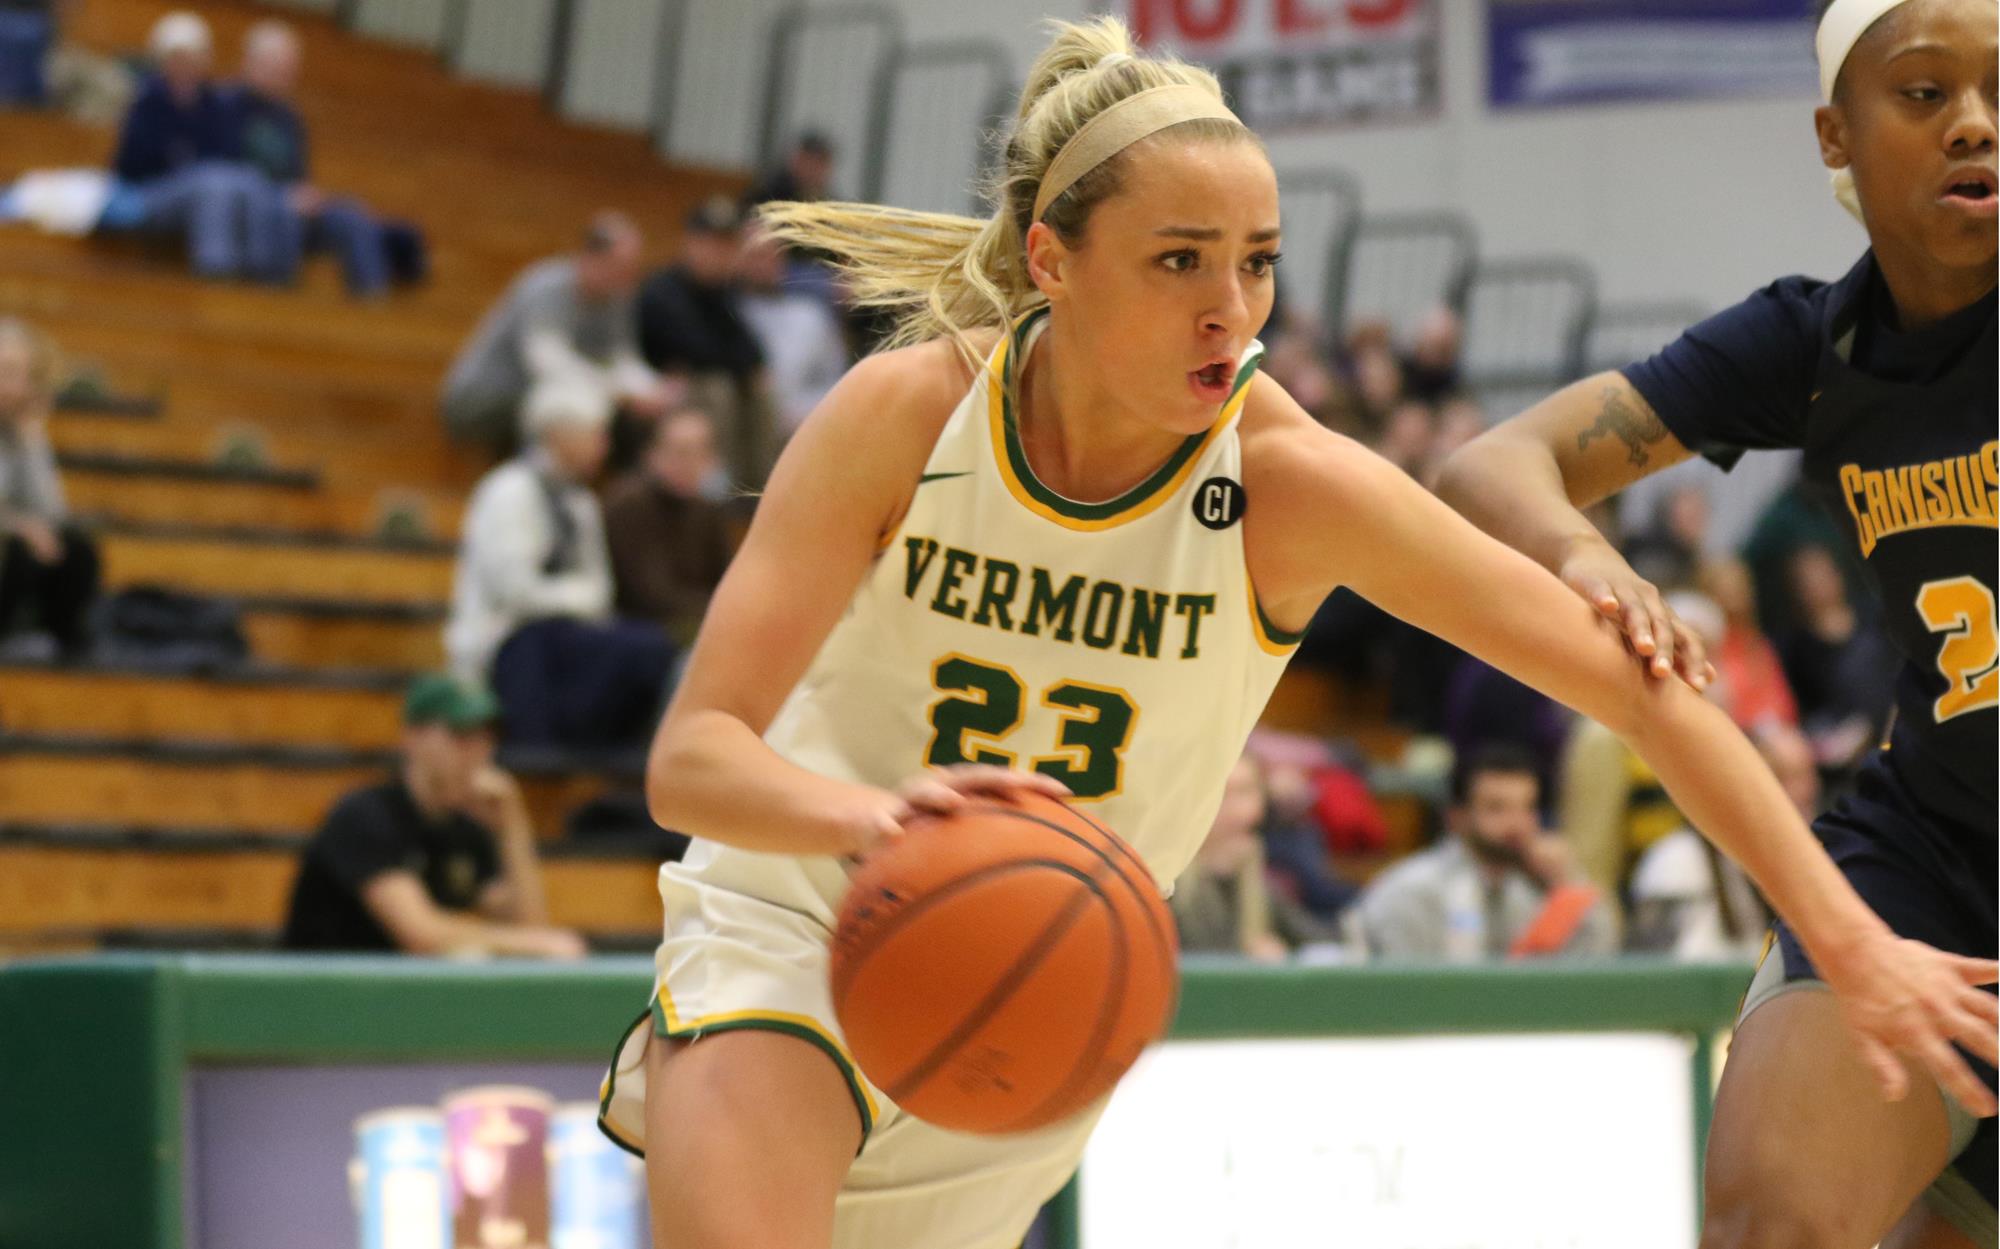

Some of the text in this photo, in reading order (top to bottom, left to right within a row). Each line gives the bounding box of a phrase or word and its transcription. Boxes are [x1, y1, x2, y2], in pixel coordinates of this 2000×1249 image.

[1203, 483, 1232, 523] CI
[904, 535, 1217, 660] VERMONT
[1915, 574, 1998, 724] 2
[922, 651, 1141, 803] 23
